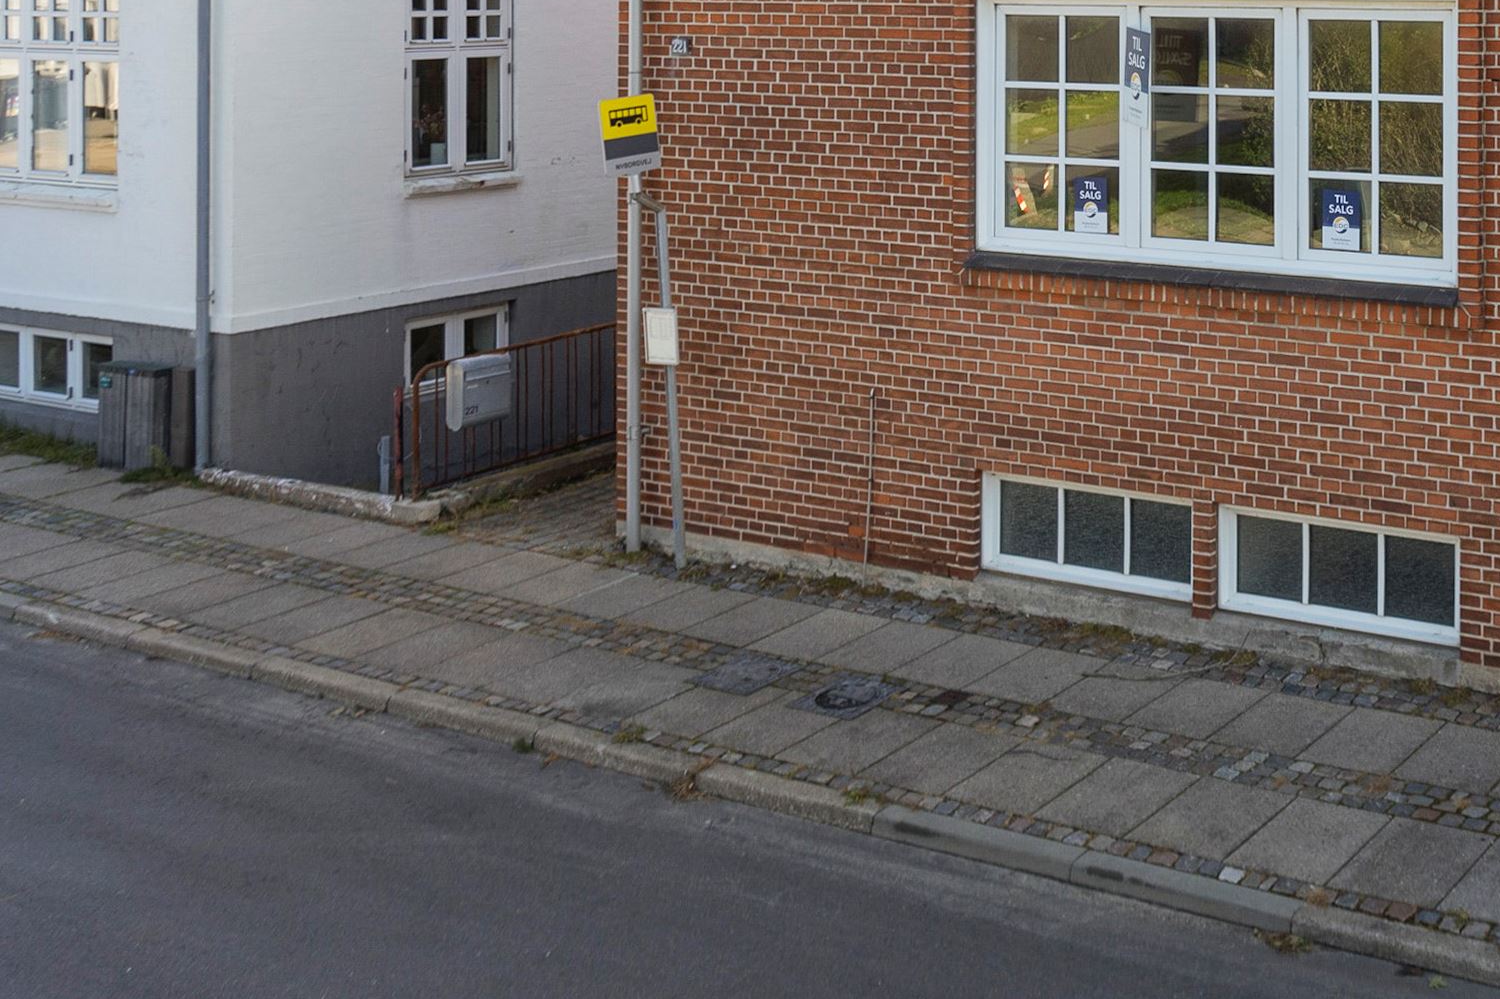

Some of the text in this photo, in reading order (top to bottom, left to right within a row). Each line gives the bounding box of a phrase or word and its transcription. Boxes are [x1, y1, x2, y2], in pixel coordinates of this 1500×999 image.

[1132, 35, 1142, 51] TIL
[1128, 52, 1146, 70] SALG
[1084, 180, 1097, 190] TIL
[1079, 190, 1102, 201] SALG
[1334, 194, 1348, 204] TIL
[1328, 204, 1354, 215] SALG
